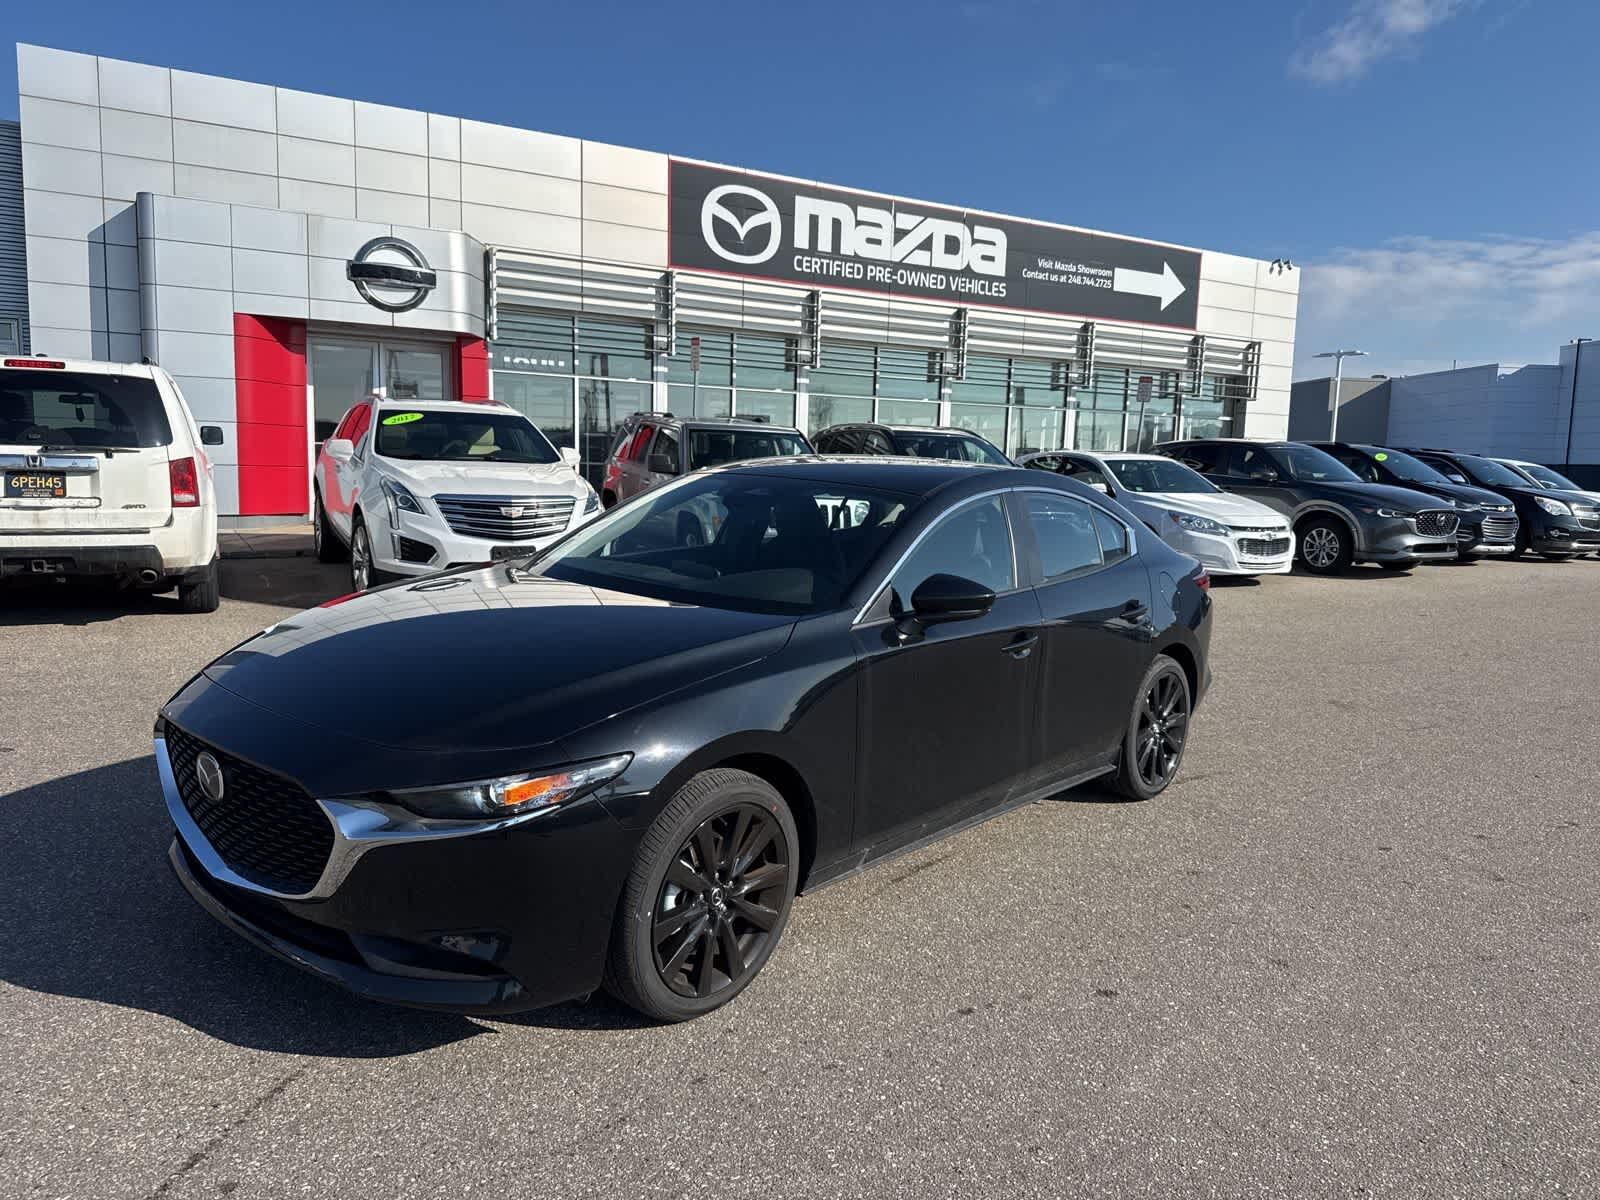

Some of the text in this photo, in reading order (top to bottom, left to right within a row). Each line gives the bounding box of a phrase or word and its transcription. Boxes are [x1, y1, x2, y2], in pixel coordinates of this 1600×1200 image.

[793, 255, 1007, 298] CERTIFIED PRE-OWNED VEHICLES
[1037, 258, 1113, 277] Visit Mazda Showroom
[1022, 268, 1112, 288] Contact us at 248.744.2725
[11, 476, 61, 488] 6PEH45
